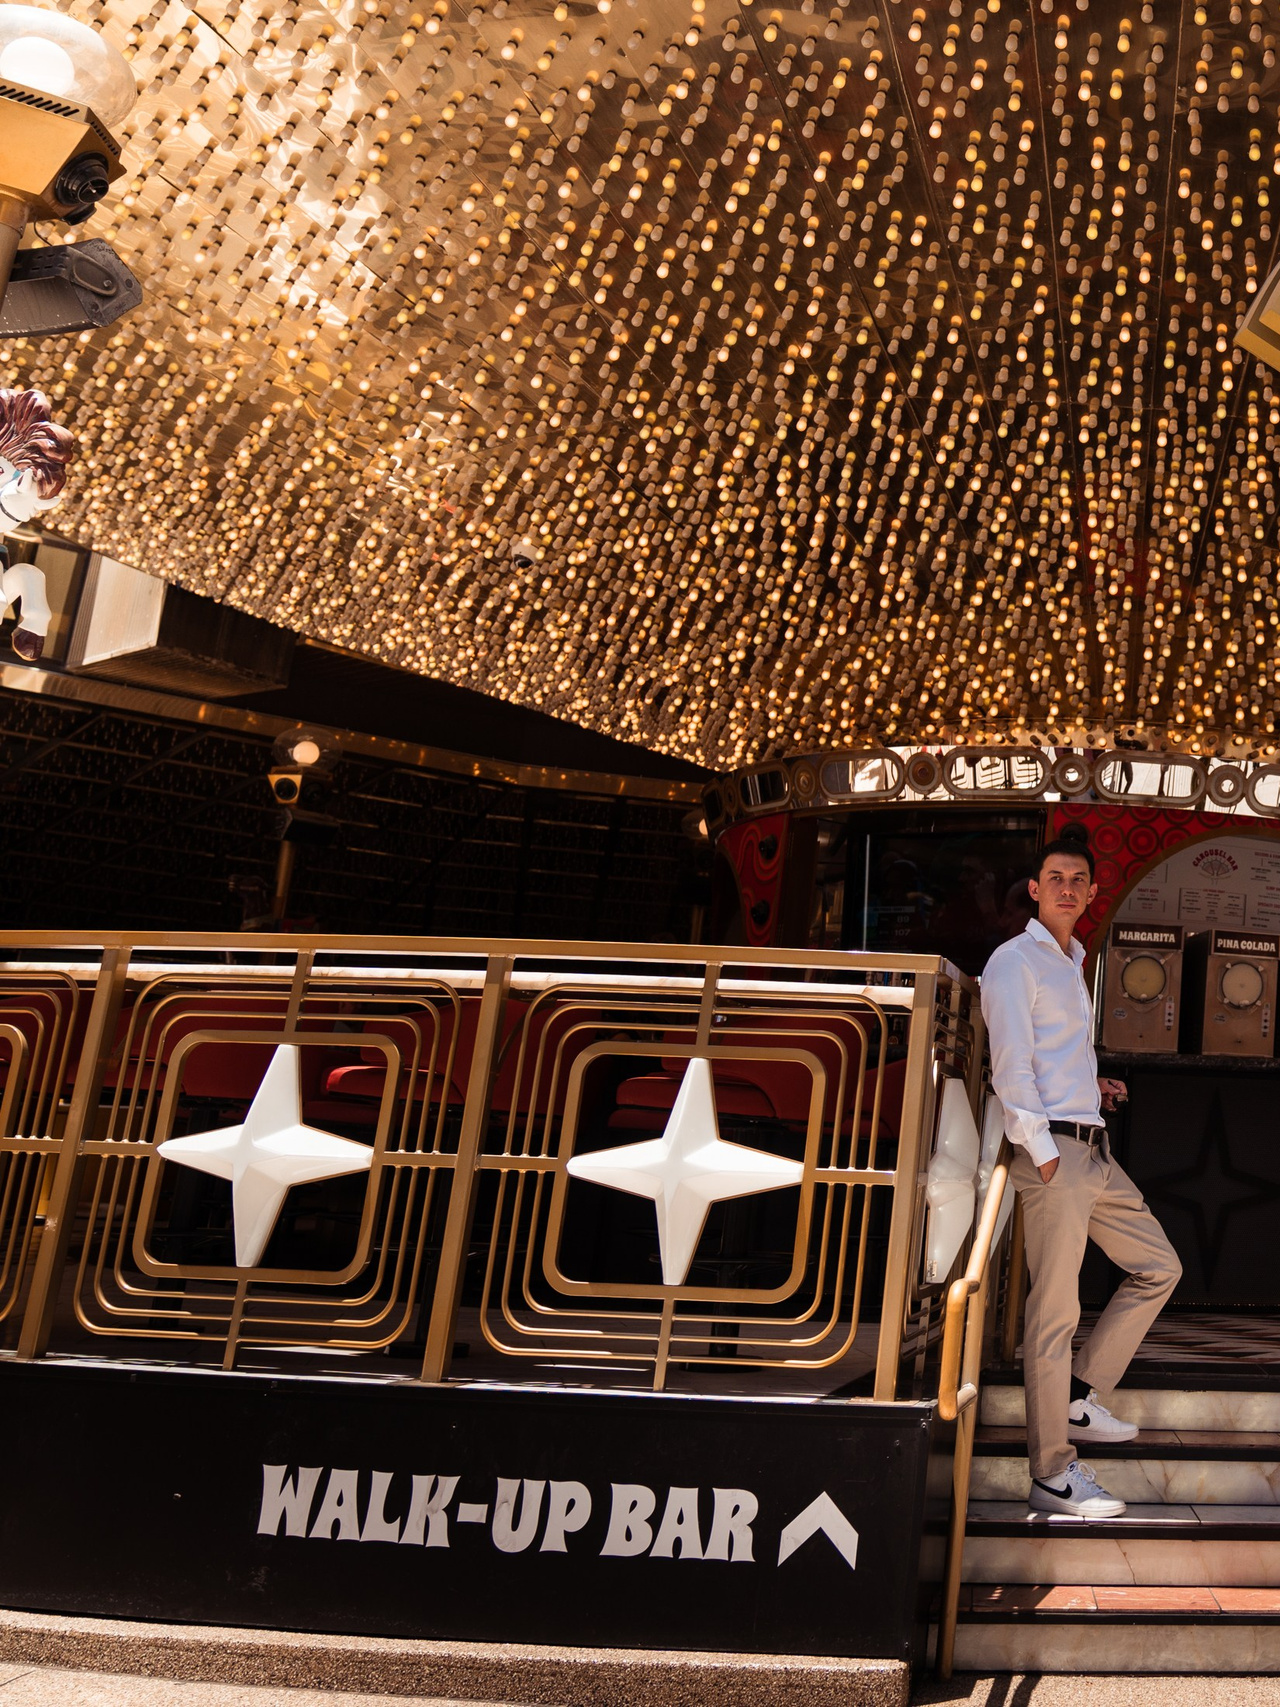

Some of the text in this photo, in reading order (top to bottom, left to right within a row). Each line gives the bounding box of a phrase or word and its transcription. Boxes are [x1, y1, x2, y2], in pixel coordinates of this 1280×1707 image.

[1193, 849, 1227, 867] CAROUSEL
[1227, 856, 1238, 871] BAR
[1119, 931, 1175, 943] MARGARITA
[1217, 938, 1276, 952] PINA COLADA
[256, 1464, 759, 1563] WALK-UP BAR
